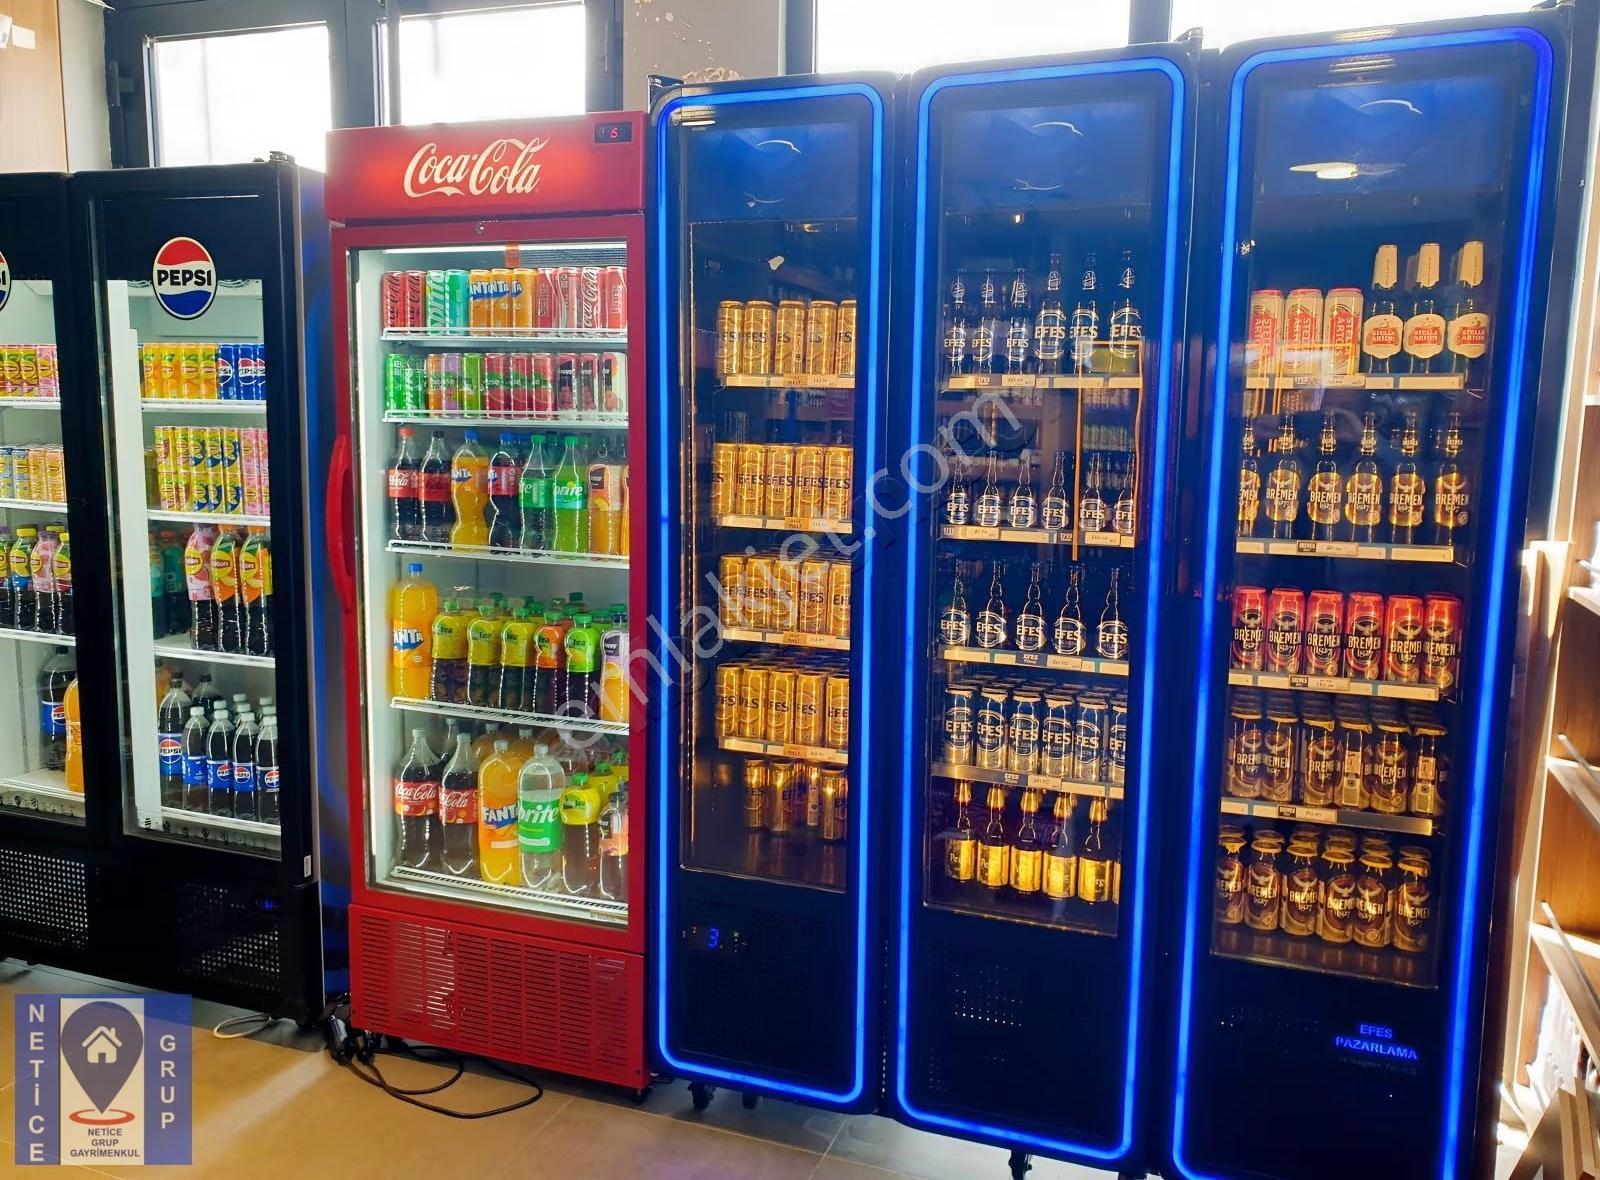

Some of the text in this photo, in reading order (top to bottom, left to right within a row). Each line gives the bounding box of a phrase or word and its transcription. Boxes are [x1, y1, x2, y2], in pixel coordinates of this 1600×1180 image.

[404, 137, 549, 198] Coca-Cola
[157, 270, 212, 287] PEPSI
[1035, 325, 1065, 339] EFES
[941, 620, 966, 630] EFES
[976, 622, 1001, 634] EFES
[1017, 625, 1042, 637] EFES
[1055, 628, 1080, 641] EFES
[1100, 632, 1128, 644] EFES
[828, 706, 848, 718] EFE
[946, 720, 972, 732] EFES
[1010, 726, 1039, 741] EFES
[1043, 730, 1071, 745] EFES
[1360, 1024, 1393, 1039] EFES
[1335, 1036, 1418, 1061] PAZARLAMA
